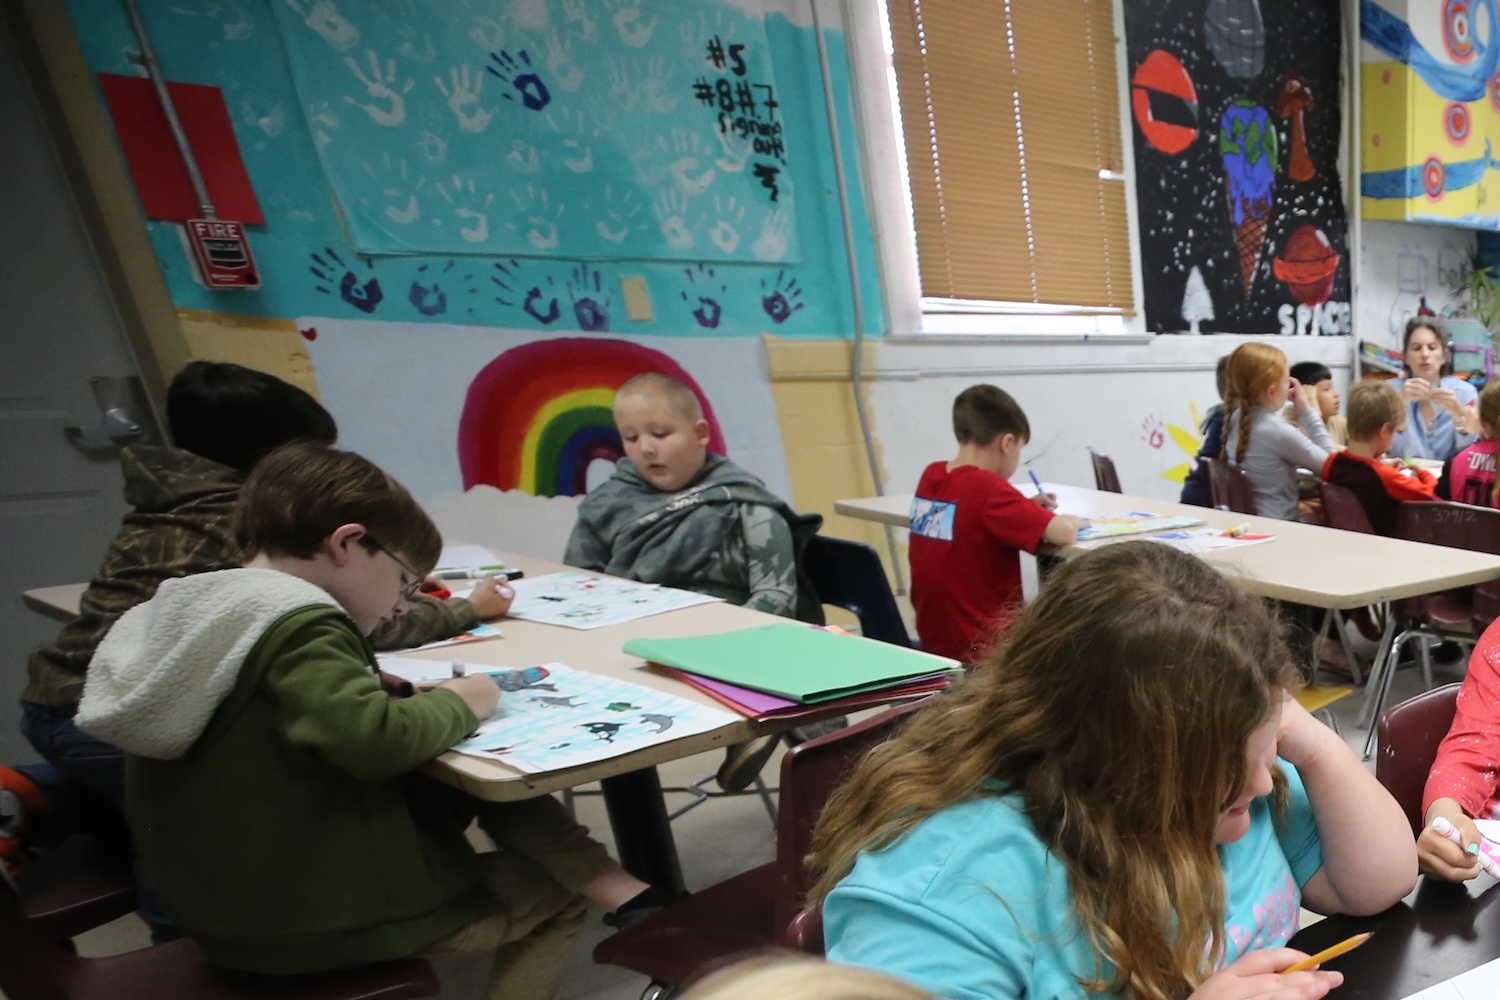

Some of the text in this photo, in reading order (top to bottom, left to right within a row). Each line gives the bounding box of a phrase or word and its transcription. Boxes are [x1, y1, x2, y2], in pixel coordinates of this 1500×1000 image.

[706, 34, 747, 76] #5
[195, 223, 240, 238] FIRE
[1278, 301, 1352, 336] SPACE
